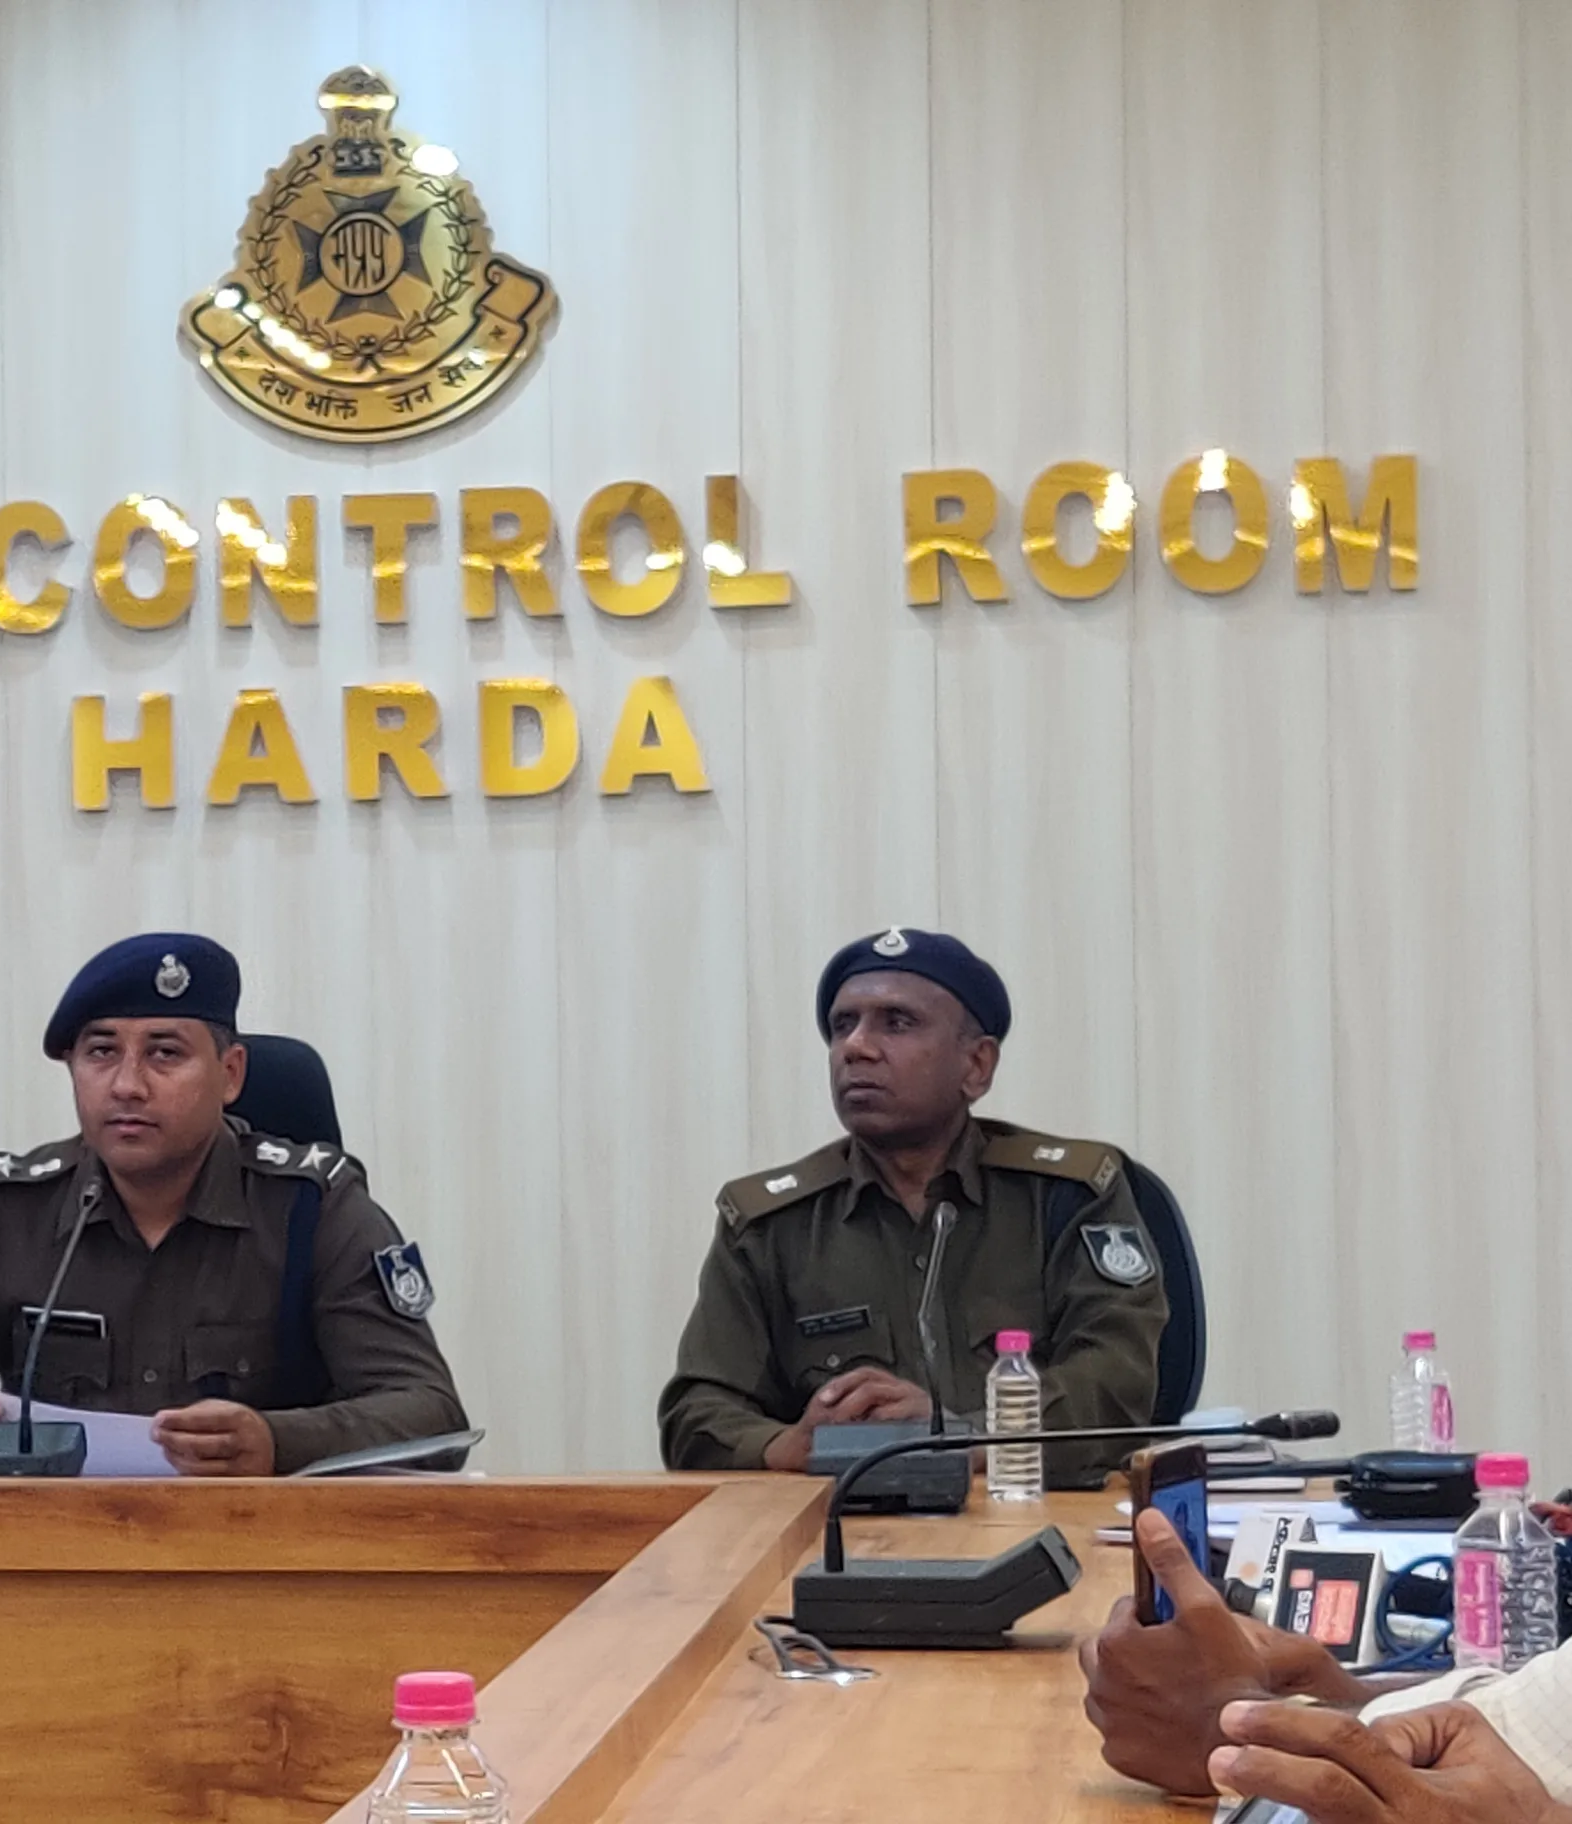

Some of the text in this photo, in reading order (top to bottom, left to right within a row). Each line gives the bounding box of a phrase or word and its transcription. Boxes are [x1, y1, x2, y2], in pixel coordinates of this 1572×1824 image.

[258, 361, 304, 406] देश
[304, 388, 359, 420] भक्ति
[387, 381, 433, 413] जन
[901, 448, 1420, 607] ROOM
[71, 675, 713, 812] HARDA
